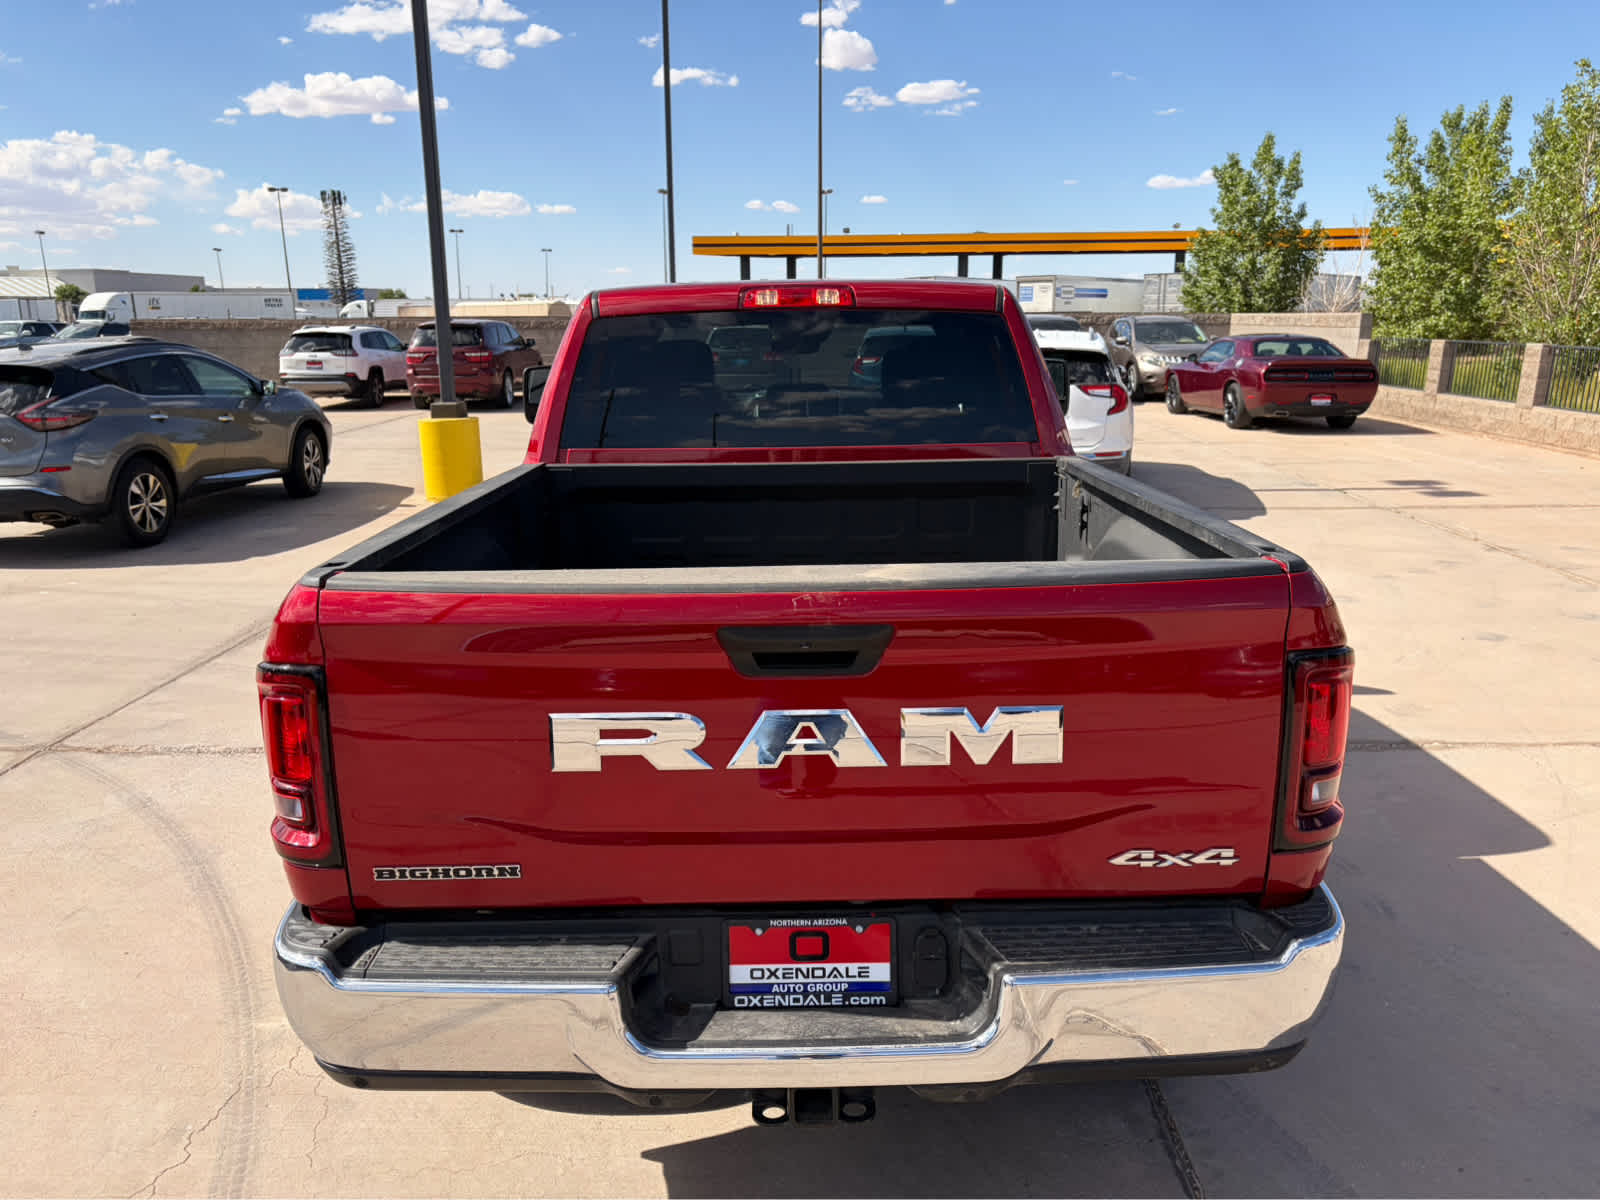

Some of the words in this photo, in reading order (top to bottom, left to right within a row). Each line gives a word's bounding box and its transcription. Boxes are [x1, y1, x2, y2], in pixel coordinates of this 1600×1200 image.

[548, 705, 1064, 772] RAM
[1108, 848, 1241, 868] 4x4
[373, 864, 521, 881] BIGHORN
[769, 919, 811, 927] NORTHERN
[813, 918, 848, 926] ARIZONA
[750, 966, 870, 980] OXENDALE
[771, 984, 804, 993] AUTO
[807, 983, 849, 992] GROUP
[734, 994, 886, 1008] OXENDALE.com
